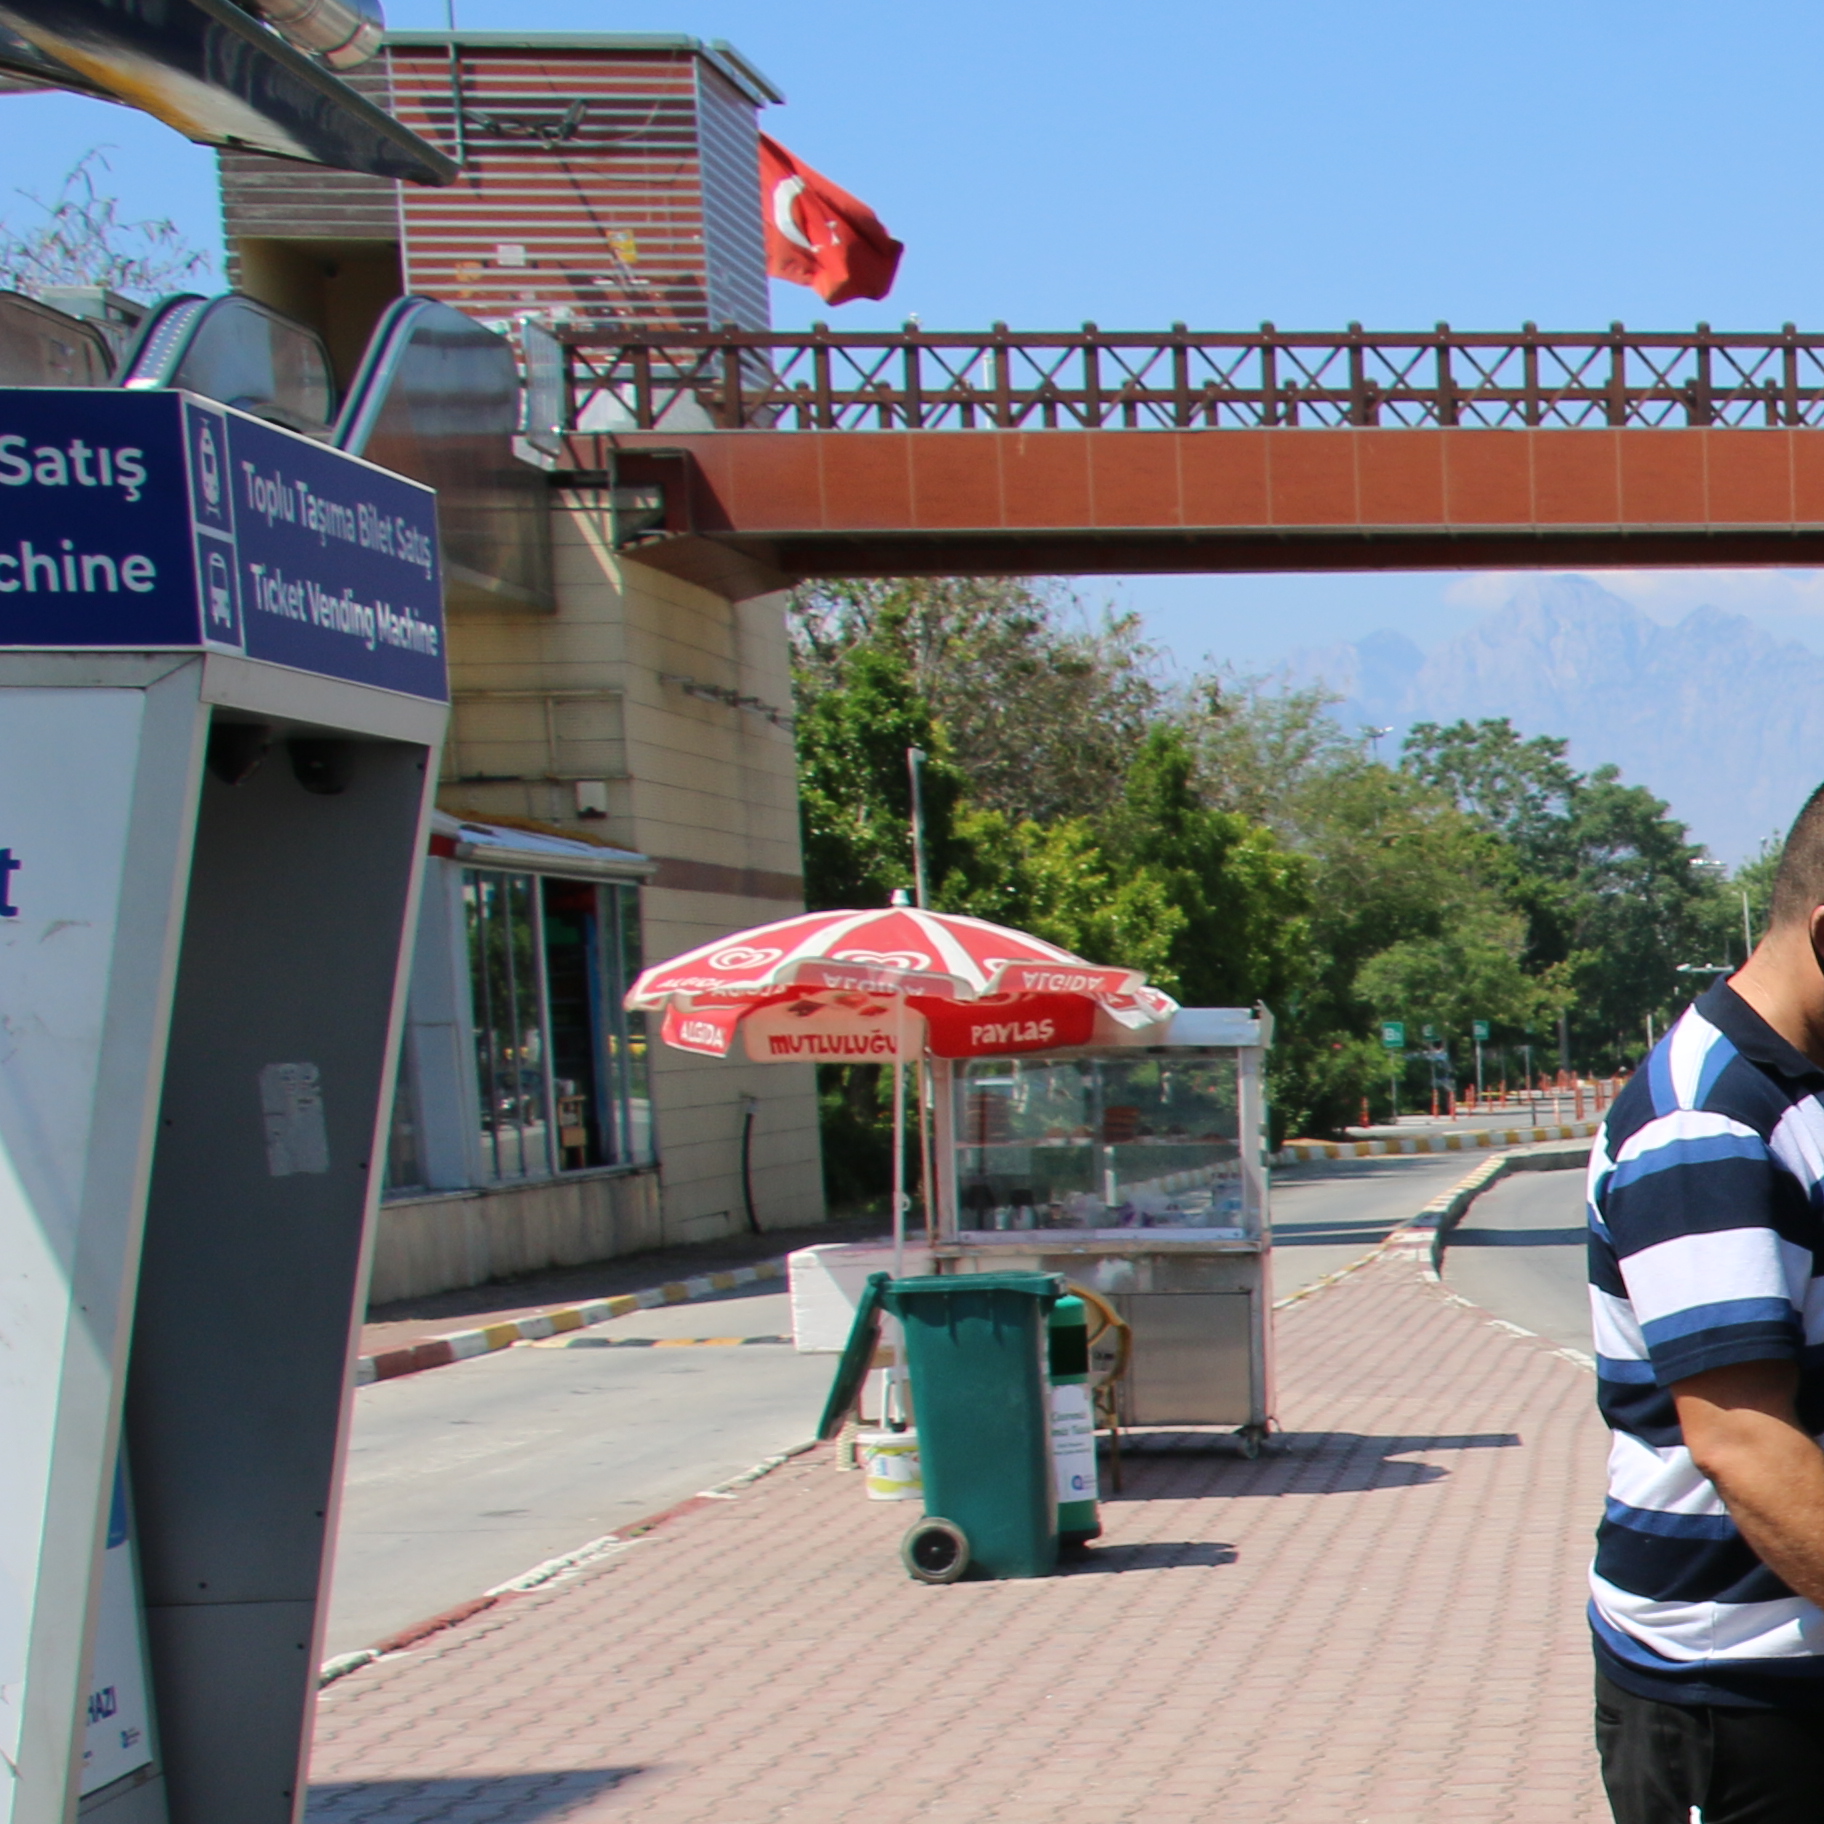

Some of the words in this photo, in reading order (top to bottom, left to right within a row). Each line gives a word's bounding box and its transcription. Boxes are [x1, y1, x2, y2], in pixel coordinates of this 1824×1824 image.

[0, 433, 147, 502] Satış
[241, 460, 295, 528] Toplu
[295, 479, 356, 547] Taşıma
[357, 502, 395, 556] Bilet
[394, 516, 432, 581] Satış
[250, 562, 307, 622] Ticket
[306, 579, 376, 651] Vending
[374, 600, 438, 656] Machine
